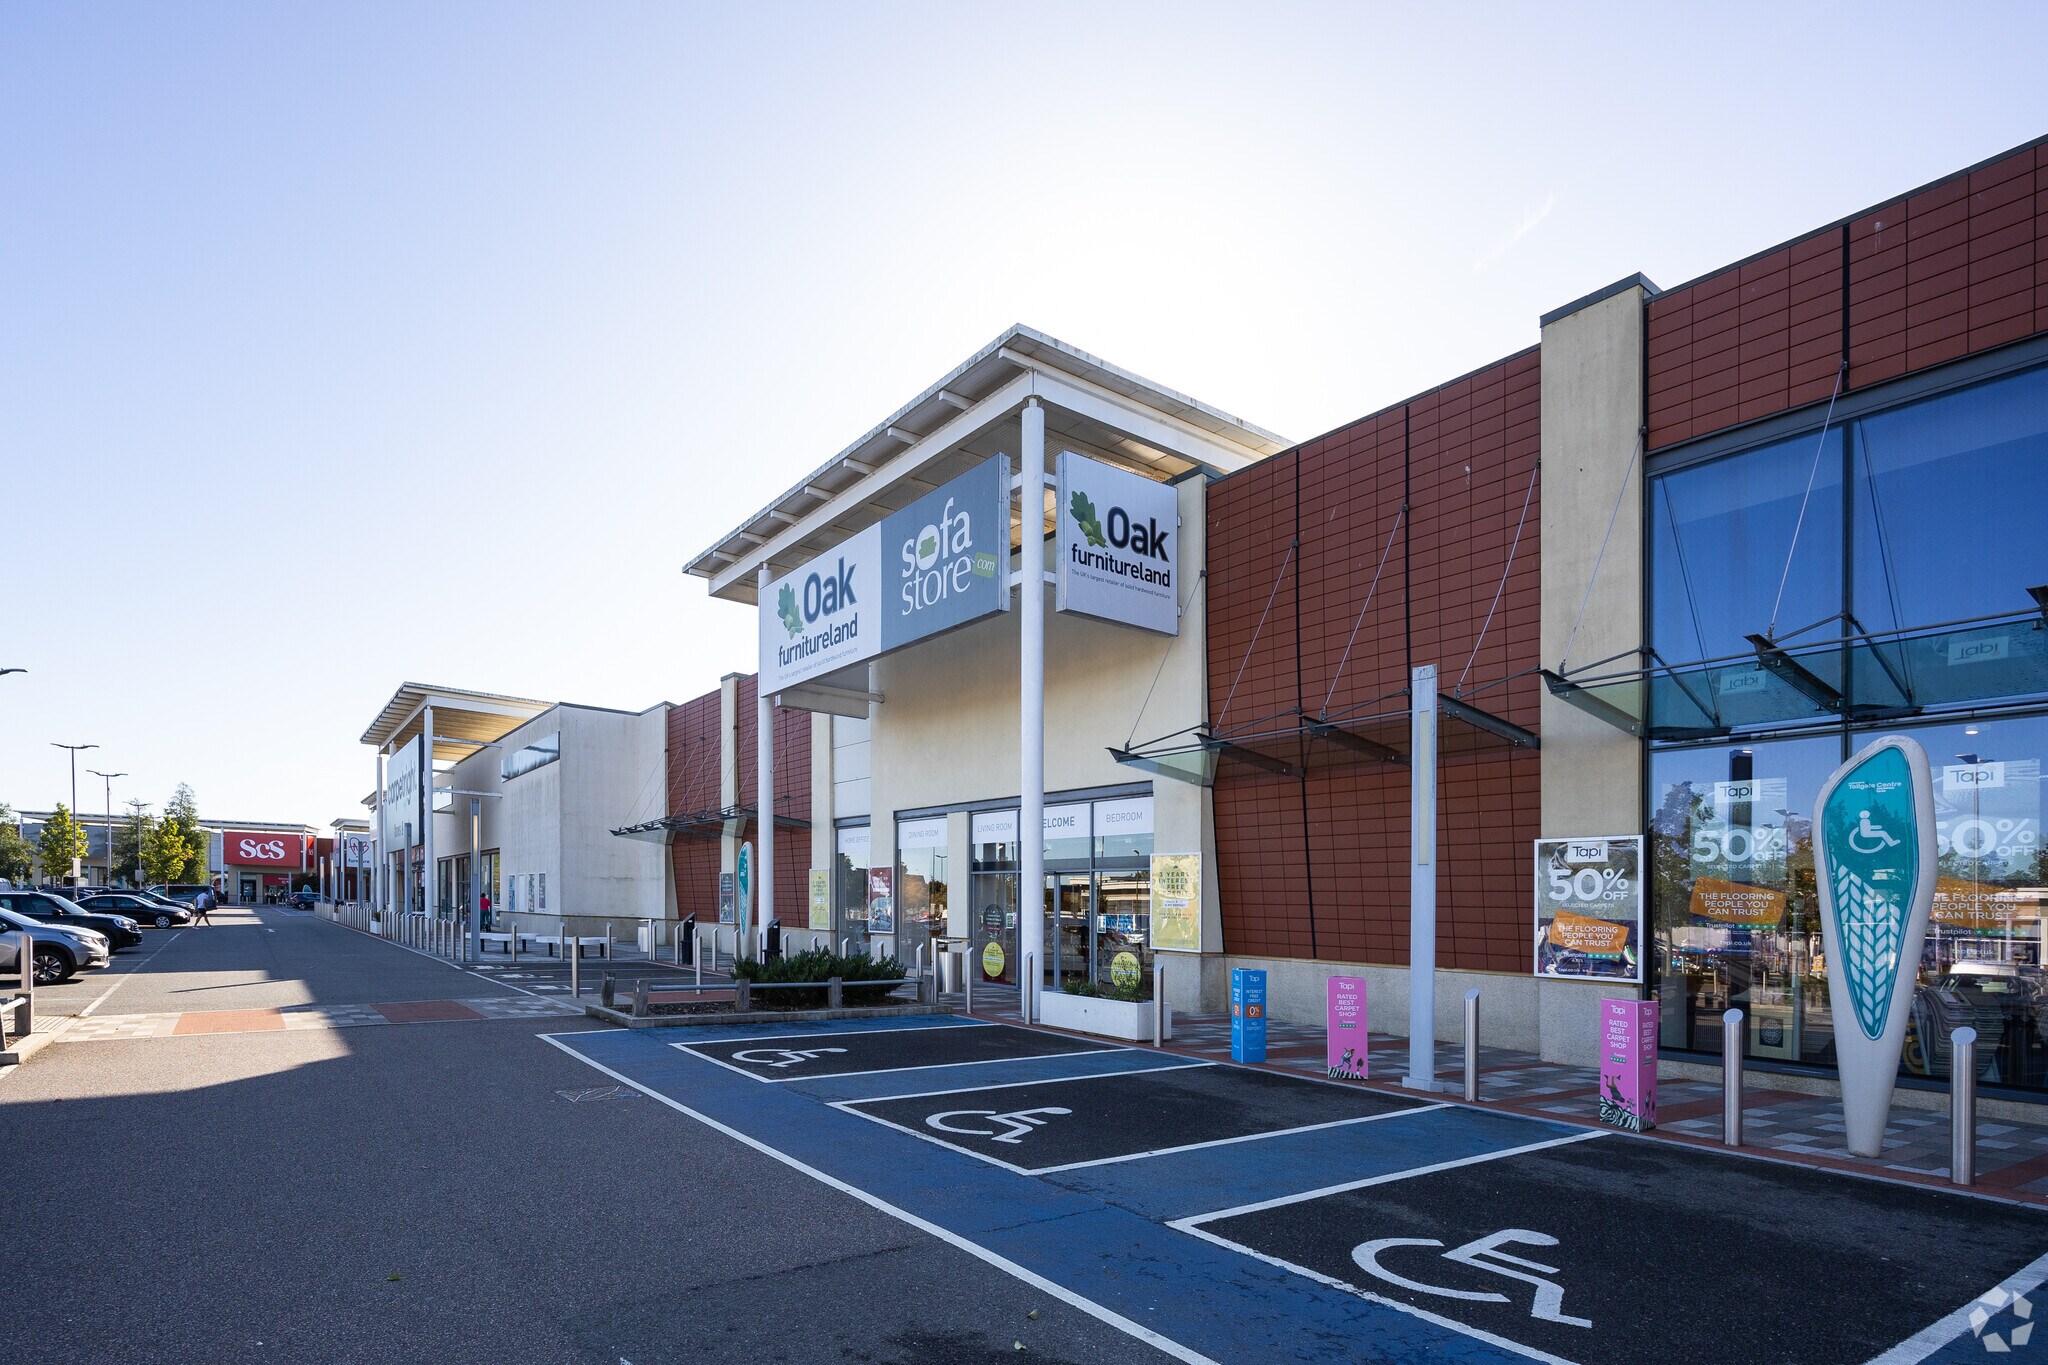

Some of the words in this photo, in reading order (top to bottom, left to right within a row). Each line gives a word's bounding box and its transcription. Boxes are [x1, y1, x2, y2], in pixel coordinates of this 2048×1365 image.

[902, 496, 973, 578] sofa
[1107, 505, 1170, 563] Oak
[1071, 543, 1171, 588] furnitureland
[803, 556, 858, 624] Oak
[902, 556, 972, 616] store
[1090, 574, 1104, 582] largest
[1105, 578, 1120, 586] retailer
[1125, 582, 1134, 590] solid
[1135, 585, 1154, 595] hardwood
[1154, 590, 1170, 600] furniture
[778, 612, 859, 668] furnitureland
[1950, 769, 1994, 785] Tapi
[1720, 785, 1753, 799] Tapi
[1043, 815, 1076, 829] ELCOME
[1106, 811, 1143, 823] BEDROOM
[977, 824, 996, 833] LIVING
[996, 822, 1013, 832] ROOM
[844, 836, 856, 844] HOME
[856, 835, 870, 844] OFFICE
[908, 830, 925, 839] DINING
[925, 829, 939, 838] ROOM
[239, 838, 286, 860] ScS
[1692, 828, 1784, 862] 50%
[1572, 844, 1602, 860] Tapi
[1753, 851, 1783, 861] OFF
[1996, 845, 2036, 857] OFF
[1548, 868, 1629, 901] 50%
[1602, 891, 1629, 900] OFF
[1699, 892, 1718, 900] THE
[1720, 892, 1775, 900] FLOORING
[1704, 900, 1744, 908] PEOPLE
[1745, 900, 1769, 908] YOU
[1932, 902, 1982, 911] PEOPLE
[1986, 903, 2016, 912] YOU
[1732, 908, 1766, 916] TRUST
[1936, 911, 1964, 920] CAN
[1968, 912, 2013, 920] TRUST
[1557, 924, 1574, 932] THE
[1574, 926, 1619, 934] FLOORING
[1706, 922, 1735, 930] Trustpilot
[1933, 928, 1972, 936] Trustpilot
[1338, 982, 1355, 990] Tapi
[1249, 1006, 1260, 1016] 0%
[1611, 1004, 1626, 1015] Tapi
[1608, 1019, 1628, 1028] RATED
[1610, 1026, 1625, 1034] BEST
[1606, 1034, 1630, 1043] CARPET
